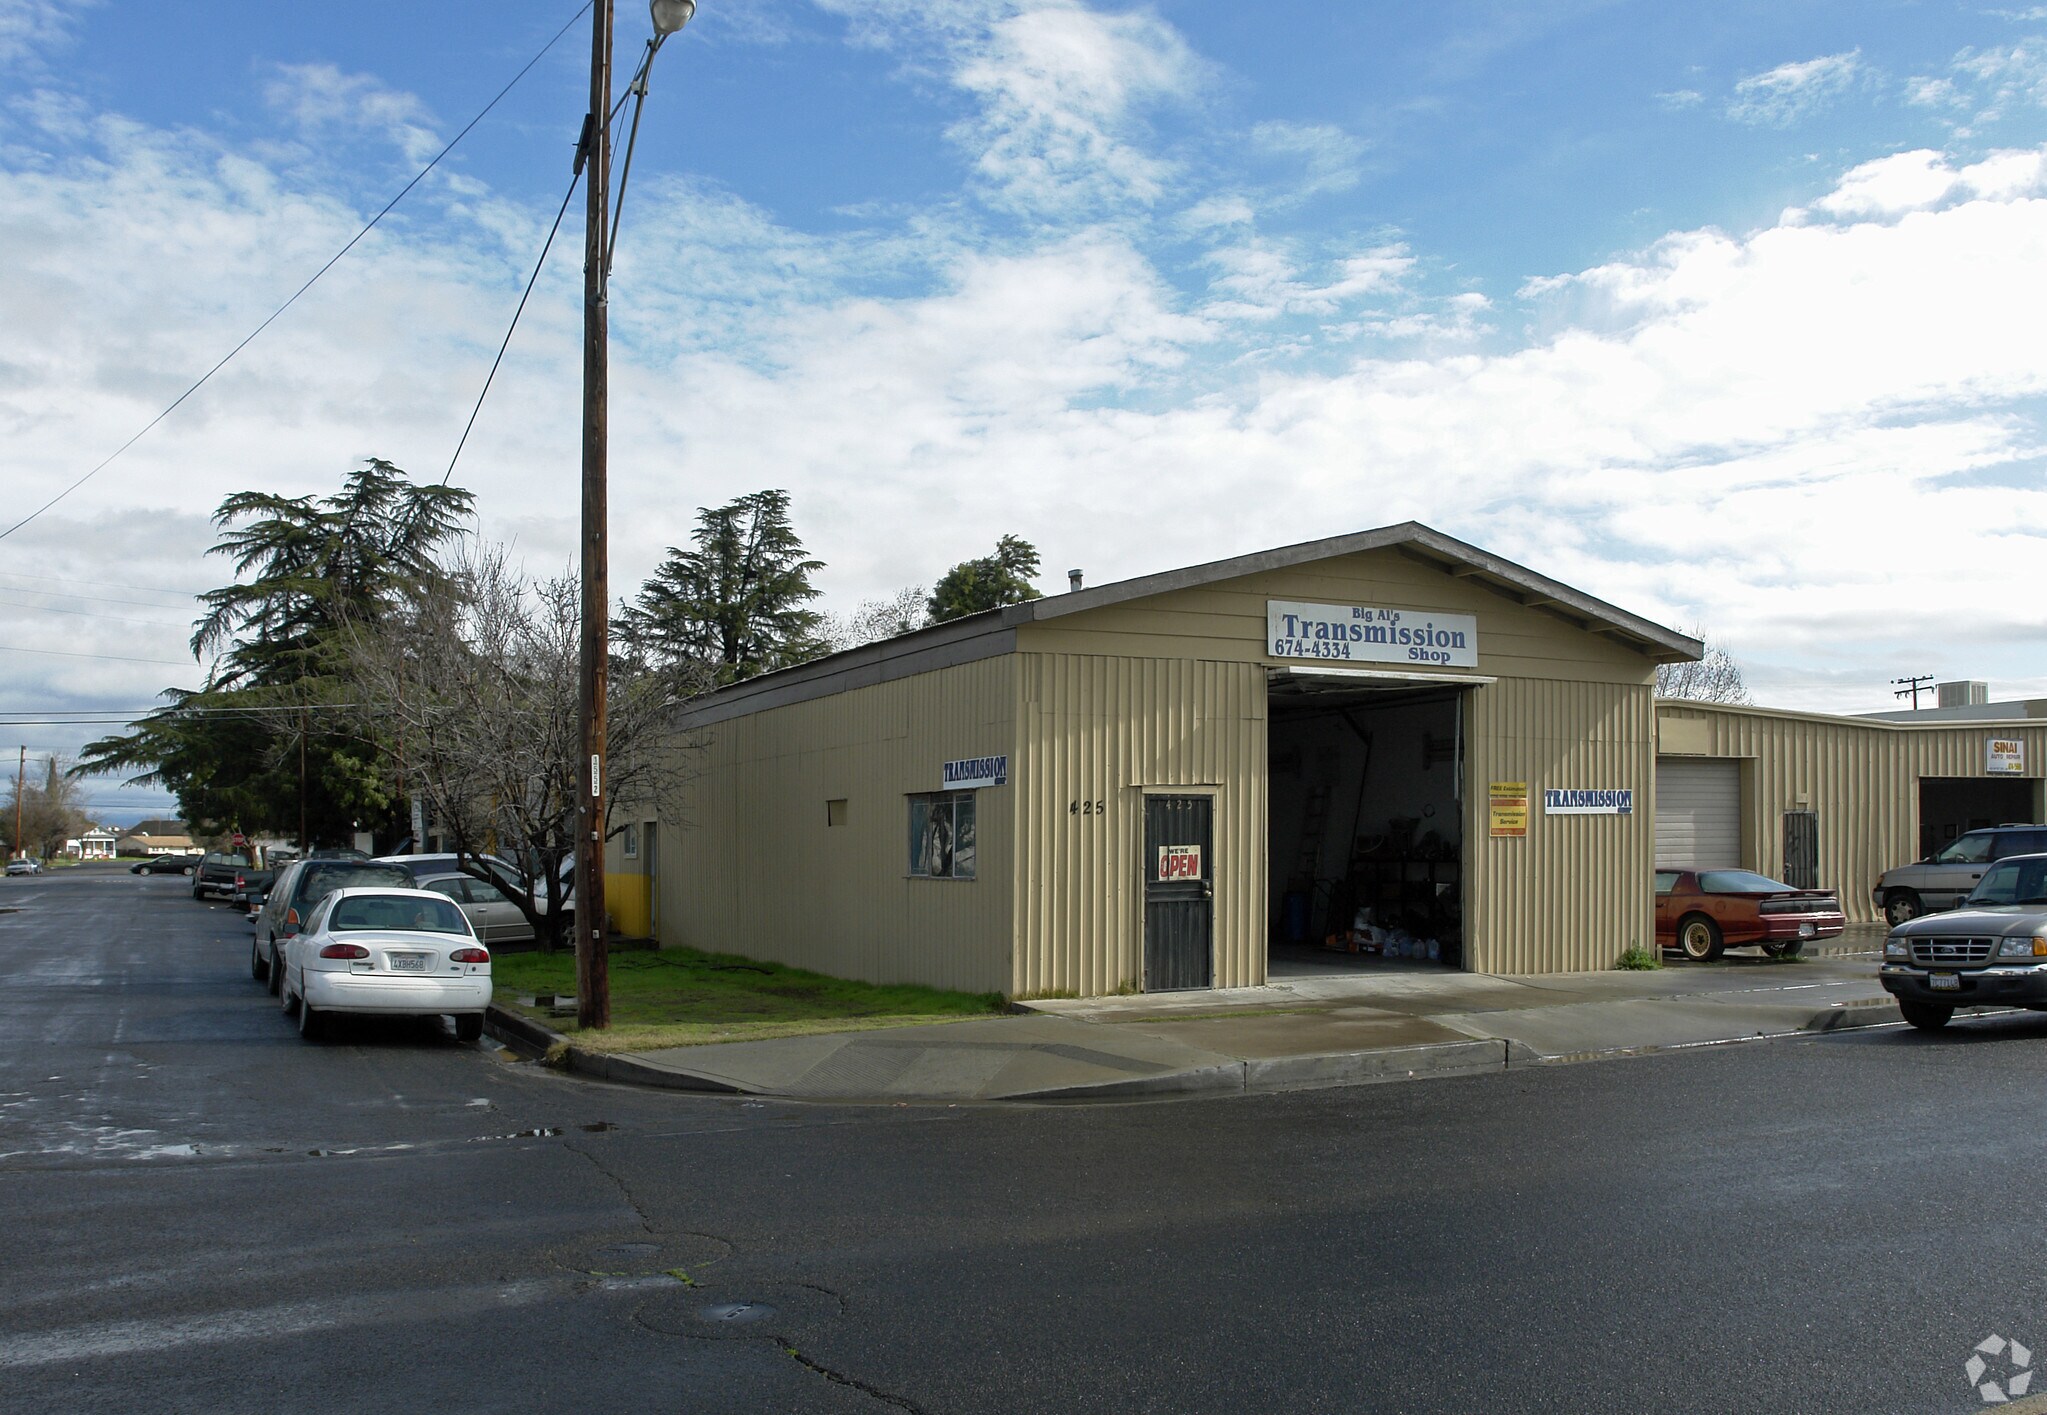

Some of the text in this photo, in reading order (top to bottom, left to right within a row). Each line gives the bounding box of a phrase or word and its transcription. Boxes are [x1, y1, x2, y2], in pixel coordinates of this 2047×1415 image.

[1352, 607, 1400, 622] Big Al's
[1282, 613, 1466, 649] Transmission
[1275, 639, 1351, 659] 674-4334
[1408, 646, 1451, 665] Shop
[1993, 741, 2017, 753] SINAI
[944, 756, 1007, 782] TRANSMISSION
[1069, 800, 1104, 815] 425
[1165, 800, 1193, 810] 425
[1545, 790, 1632, 808] TRANSMISSION
[1160, 854, 1199, 877] OPEN
